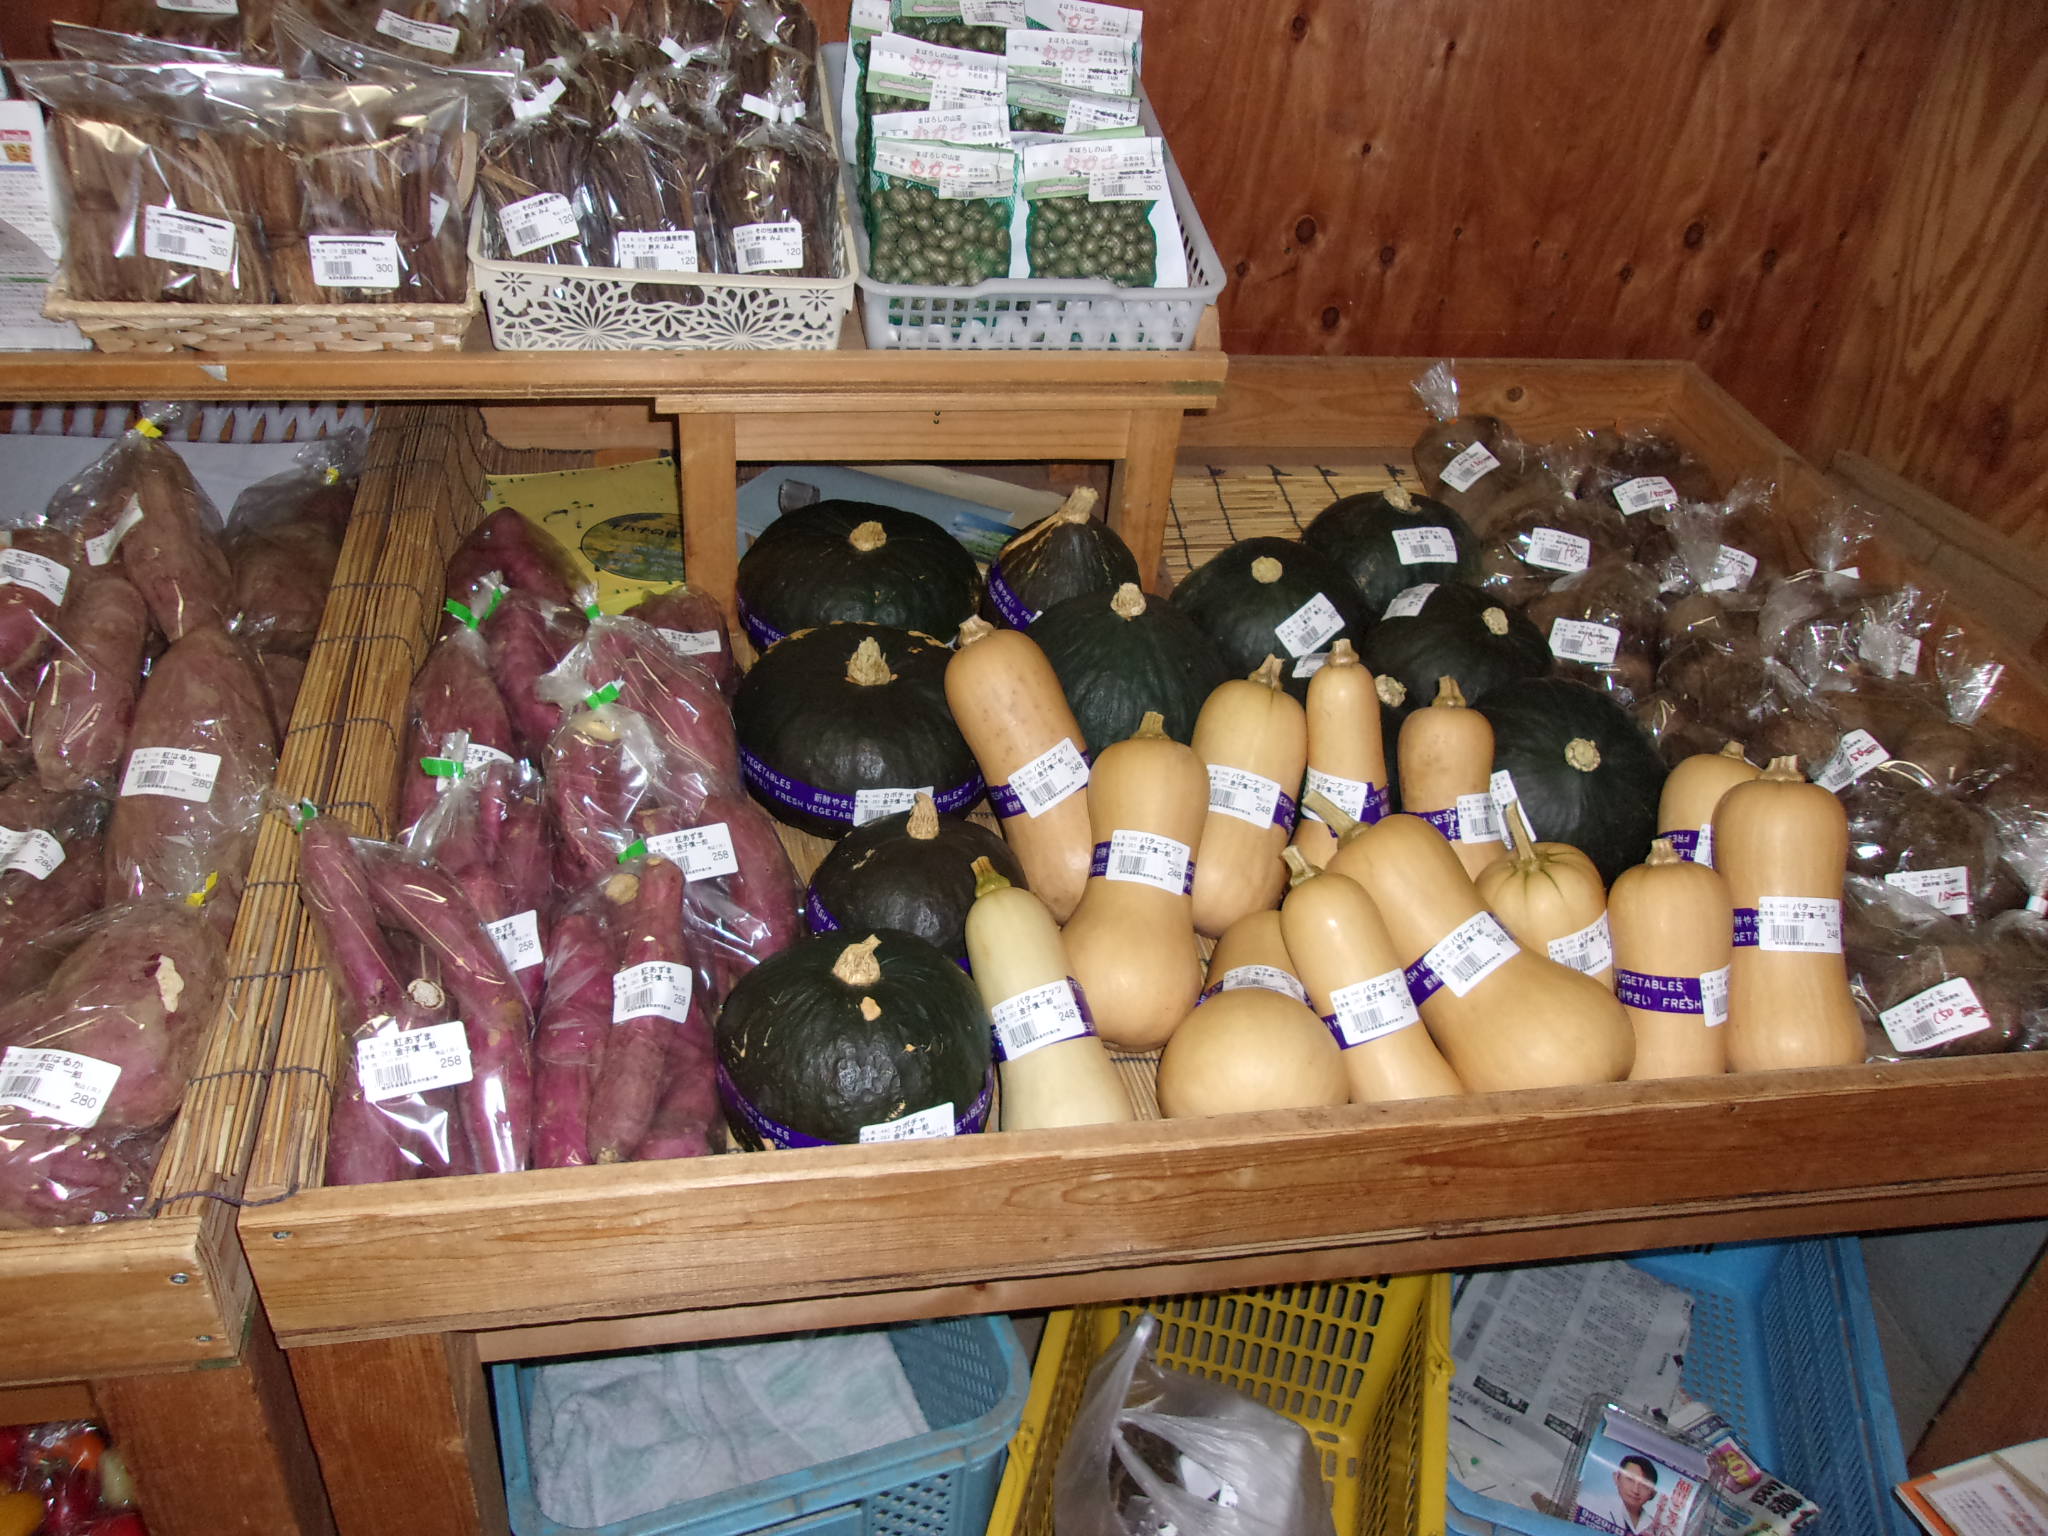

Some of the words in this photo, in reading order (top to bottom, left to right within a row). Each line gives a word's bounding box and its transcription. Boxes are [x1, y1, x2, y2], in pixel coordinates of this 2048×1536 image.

[558, 213, 574, 225] 120
[786, 247, 801, 256] 120
[680, 257, 696, 265] 120
[375, 263, 394, 273] 300
[162, 752, 197, 763] 紅はるか
[746, 754, 791, 790] VEGETABLES
[191, 778, 213, 789] 280
[1231, 773, 1274, 791] バターナッツ
[775, 790, 804, 808] FRESH
[806, 803, 854, 820] VEGETAB
[1255, 802, 1271, 815] 248
[675, 832, 704, 843] 紅あずま
[1140, 837, 1184, 855] バターナッツ
[712, 850, 729, 861] 258
[34, 856, 53, 871] 280
[1167, 867, 1182, 880] 248
[1793, 903, 1836, 912] バターナッツ
[1451, 917, 1487, 945] バターナッツ
[518, 940, 534, 952] 258
[641, 966, 672, 975] 紅あずま
[1016, 985, 1062, 1007] バターナッツ
[1662, 997, 1702, 1010] FRESH
[1058, 1008, 1076, 1021] 248
[394, 1032, 432, 1047] 紅あずま
[41, 1053, 83, 1069] 紅はるか
[440, 1055, 462, 1069] 258
[70, 1092, 97, 1109] 280
